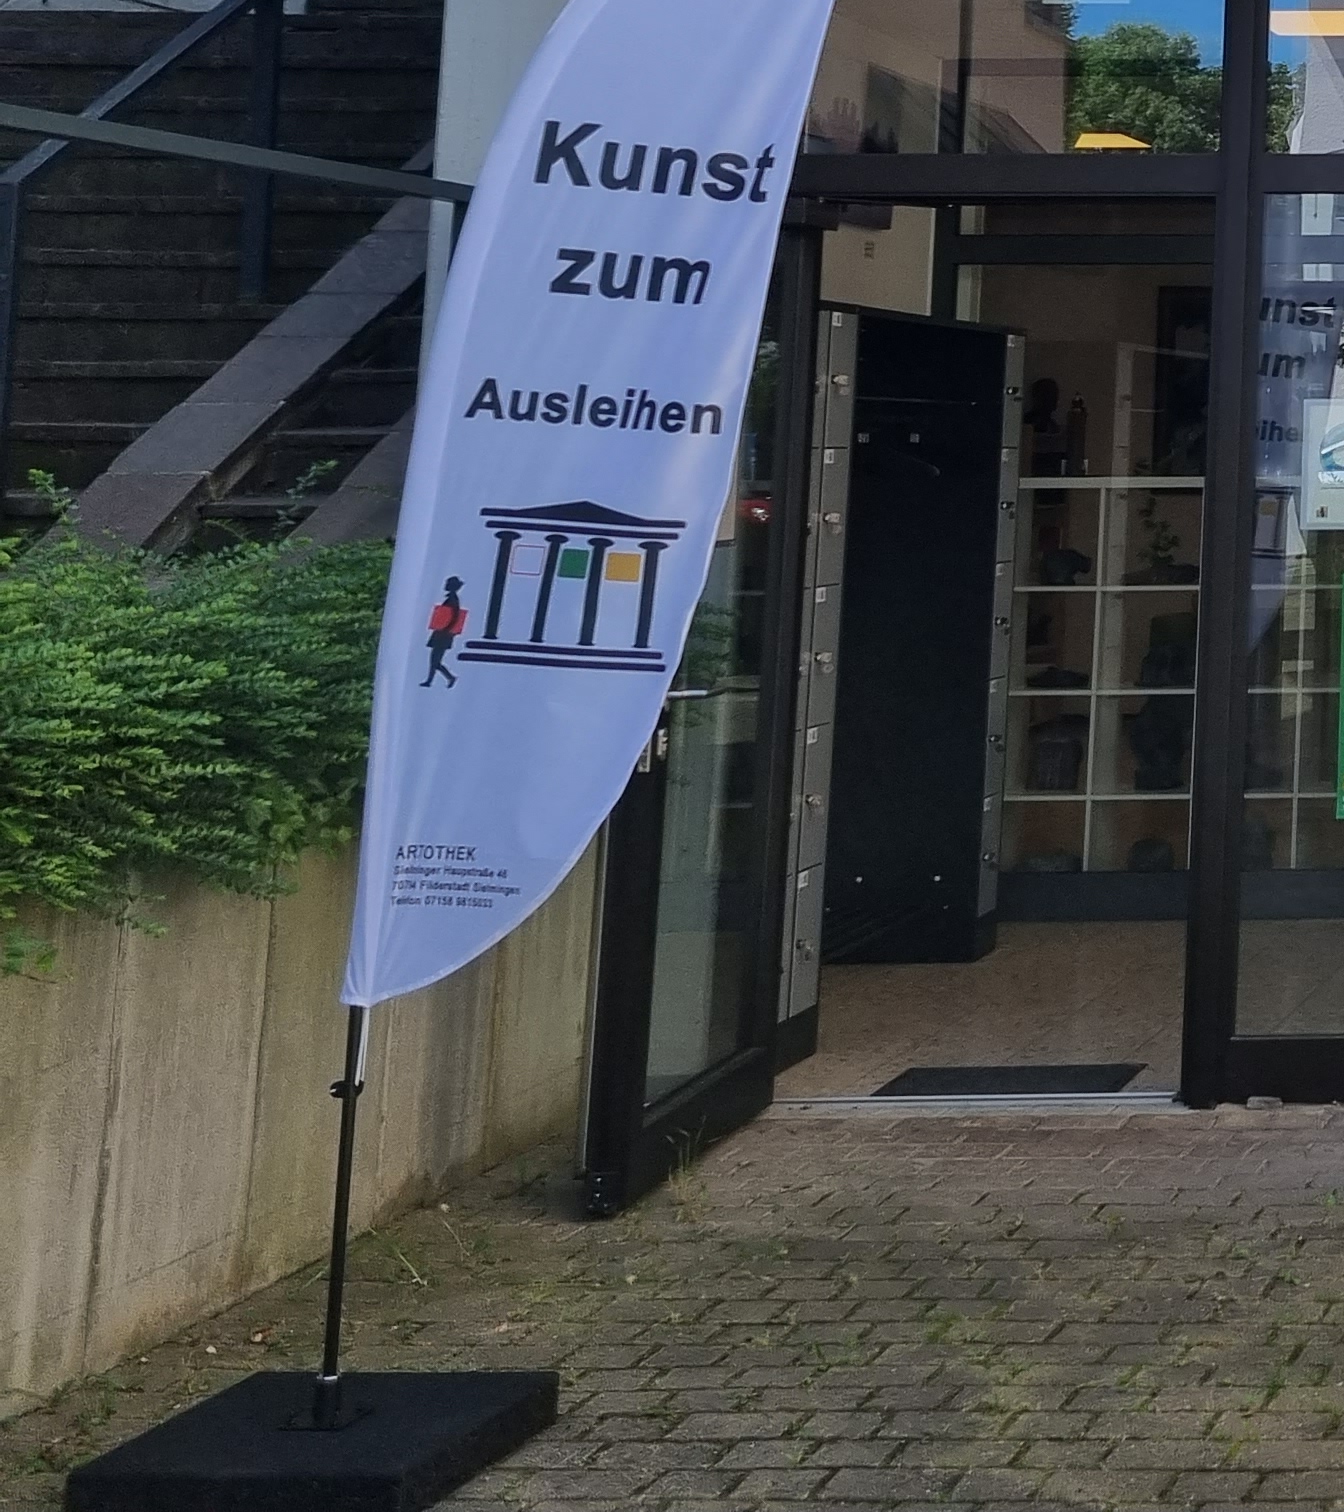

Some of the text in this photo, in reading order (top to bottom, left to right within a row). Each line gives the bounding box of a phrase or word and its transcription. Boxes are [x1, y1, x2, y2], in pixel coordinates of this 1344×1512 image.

[534, 120, 776, 204] Kunst
[548, 247, 711, 305] zum
[464, 377, 723, 435] Ausleihen
[395, 844, 477, 861] ARTOTHEK
